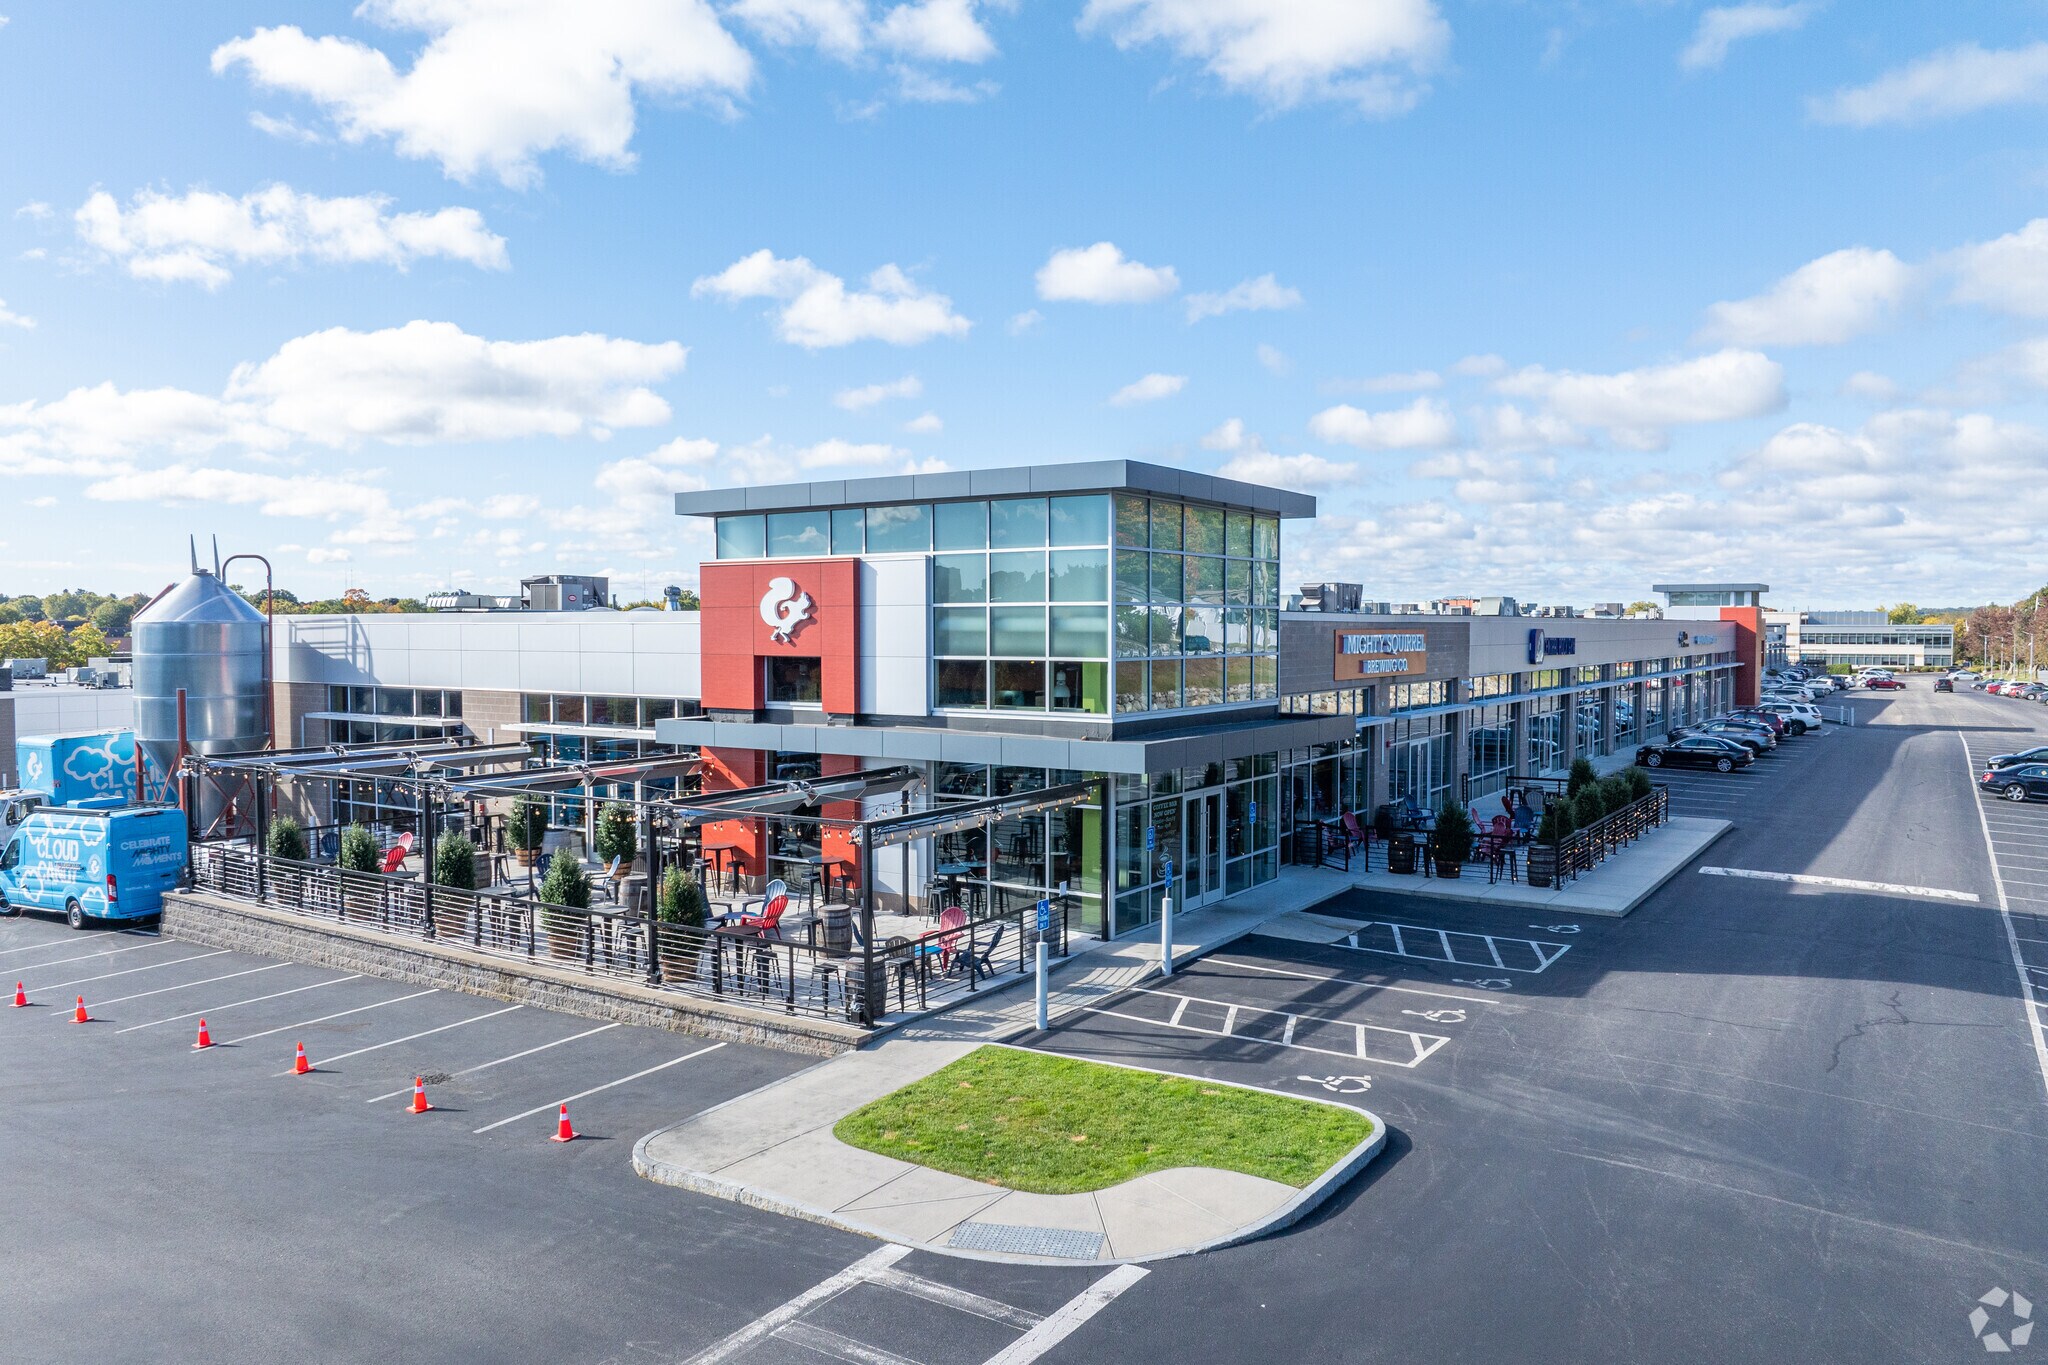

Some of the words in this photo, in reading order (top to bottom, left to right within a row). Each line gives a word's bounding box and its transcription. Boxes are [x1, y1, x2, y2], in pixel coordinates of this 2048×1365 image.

[1345, 634, 1385, 654] MIGHTY
[1386, 634, 1426, 655] SQUIRREL
[1366, 660, 1397, 674] BREWING
[37, 838, 79, 861] CLOUD
[120, 836, 171, 850] CELEBRATE
[132, 851, 183, 867] MOMENTS
